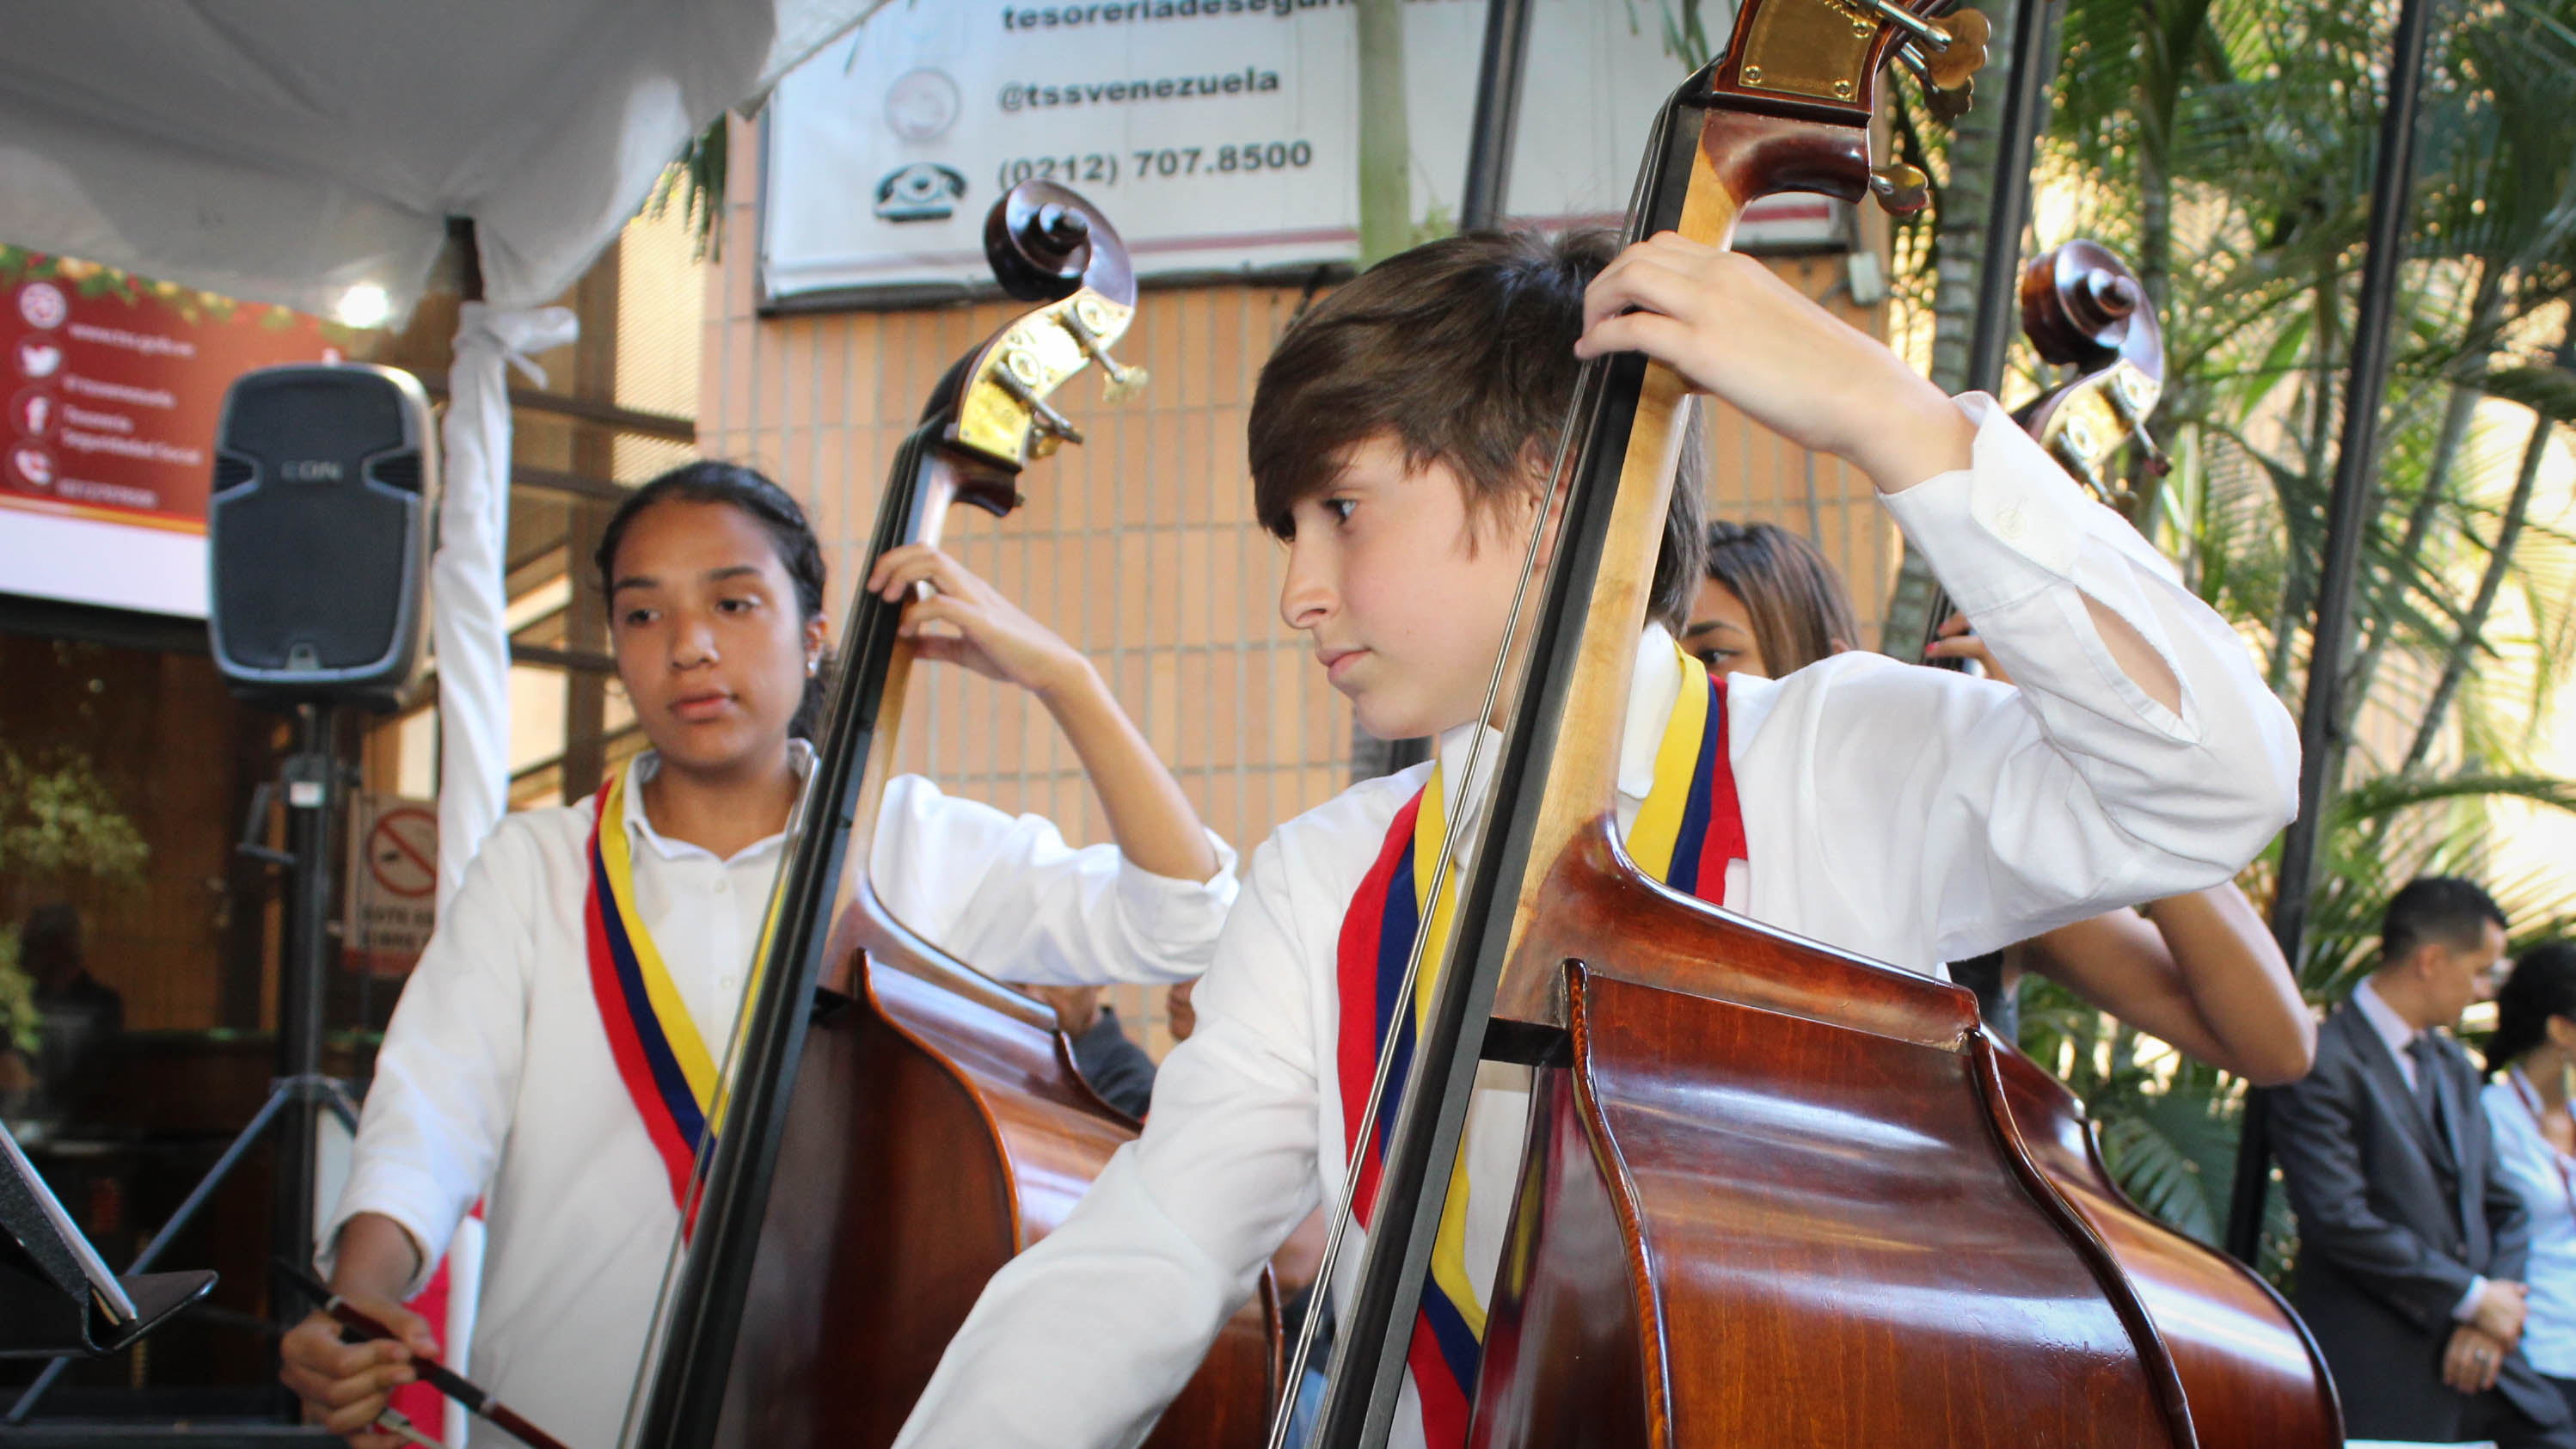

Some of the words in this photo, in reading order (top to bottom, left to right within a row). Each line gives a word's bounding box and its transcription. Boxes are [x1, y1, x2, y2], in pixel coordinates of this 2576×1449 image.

[999, 66, 1279, 112] @tssvenezuela
[998, 153, 1118, 191] (0212)
[1133, 139, 1313, 178] 707.8500
